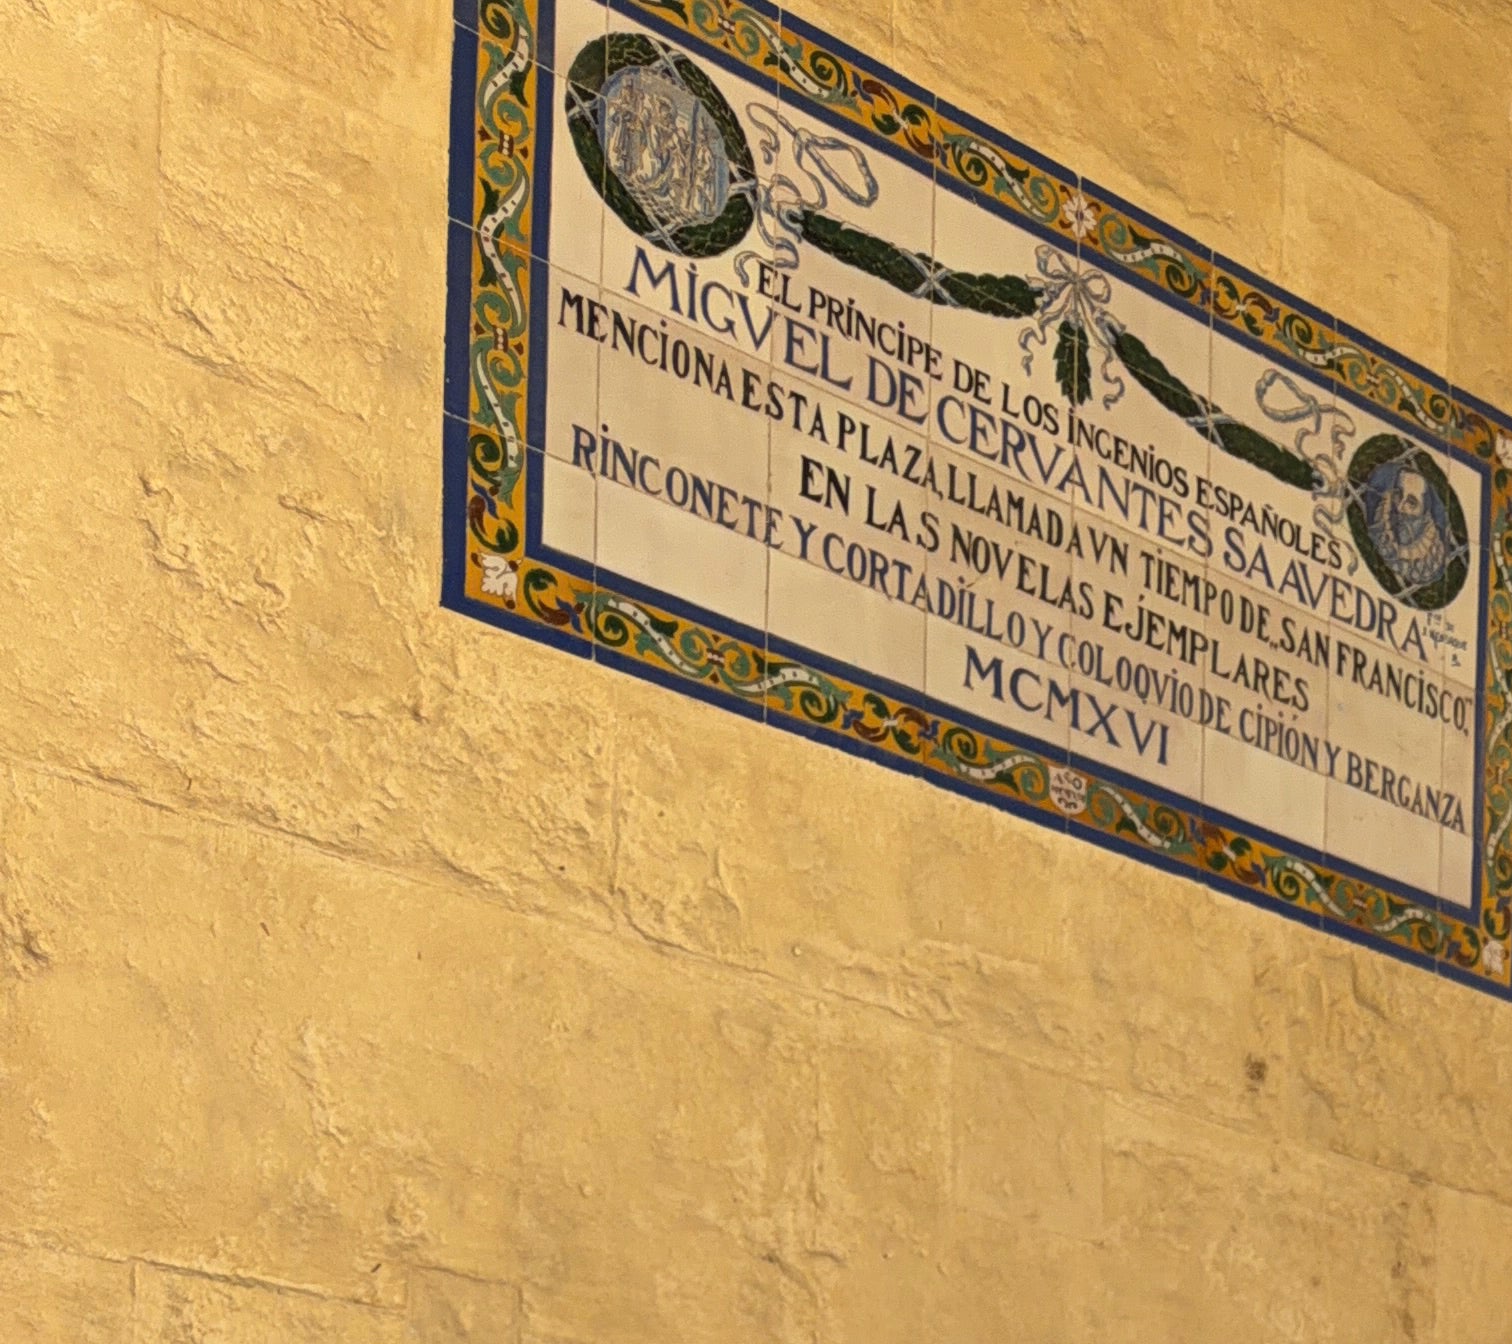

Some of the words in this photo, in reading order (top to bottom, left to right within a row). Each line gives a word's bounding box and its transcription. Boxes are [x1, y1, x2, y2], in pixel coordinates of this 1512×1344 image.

[558, 287, 734, 402] MENCIONA
[741, 368, 829, 445] ESTA
[947, 462, 1084, 559] LLAMADA
[1087, 526, 1128, 577] VN
[1140, 548, 1234, 625] TIEMPO
[1240, 595, 1270, 643] DE
[757, 260, 802, 313] EL
[952, 358, 992, 405] DE
[1001, 381, 1060, 436] LOS
[1067, 407, 1189, 498] INGENIOS
[1195, 475, 1342, 570] ESPAÑOLES
[866, 354, 929, 425] DE
[937, 395, 1213, 558] CERVANTES
[571, 424, 784, 549] RINCONETE
[790, 514, 818, 560] Y
[823, 532, 1025, 648] CORTADILLO
[1030, 617, 1053, 660] Y
[1199, 688, 1232, 735] DE
[1323, 739, 1341, 778] Y
[1346, 751, 1466, 834] BERGANZA
[799, 454, 851, 517] EN
[865, 484, 940, 553] LAS
[950, 522, 1094, 620] NOVELAS
[1102, 590, 1309, 712] EJEMPLARES
[965, 645, 1169, 766] MCMXVI
